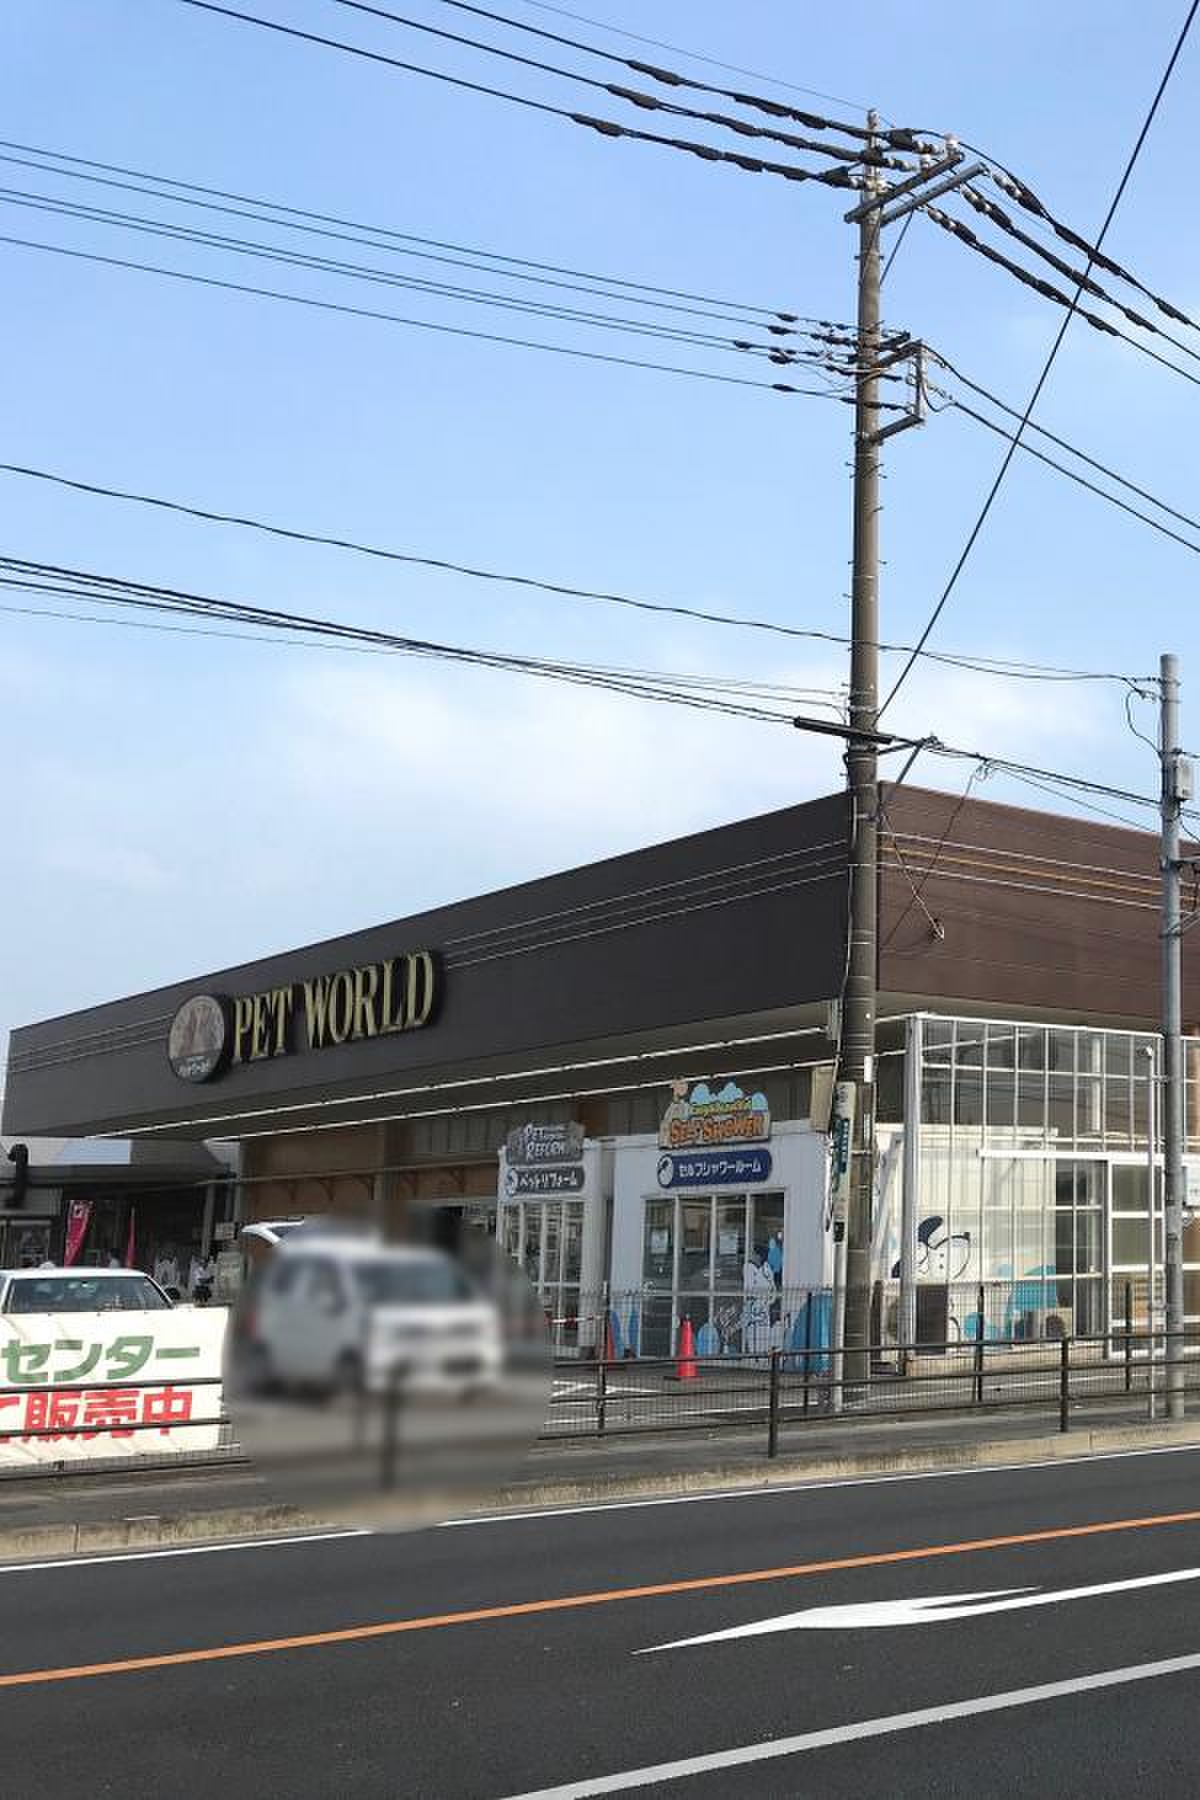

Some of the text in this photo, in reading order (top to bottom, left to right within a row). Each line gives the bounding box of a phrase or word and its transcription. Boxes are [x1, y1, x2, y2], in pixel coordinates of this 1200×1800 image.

[232, 949, 434, 1064] PET WORLD
[680, 1158, 761, 1178] セルフシャワールーム
[0, 1335, 200, 1383] センター
